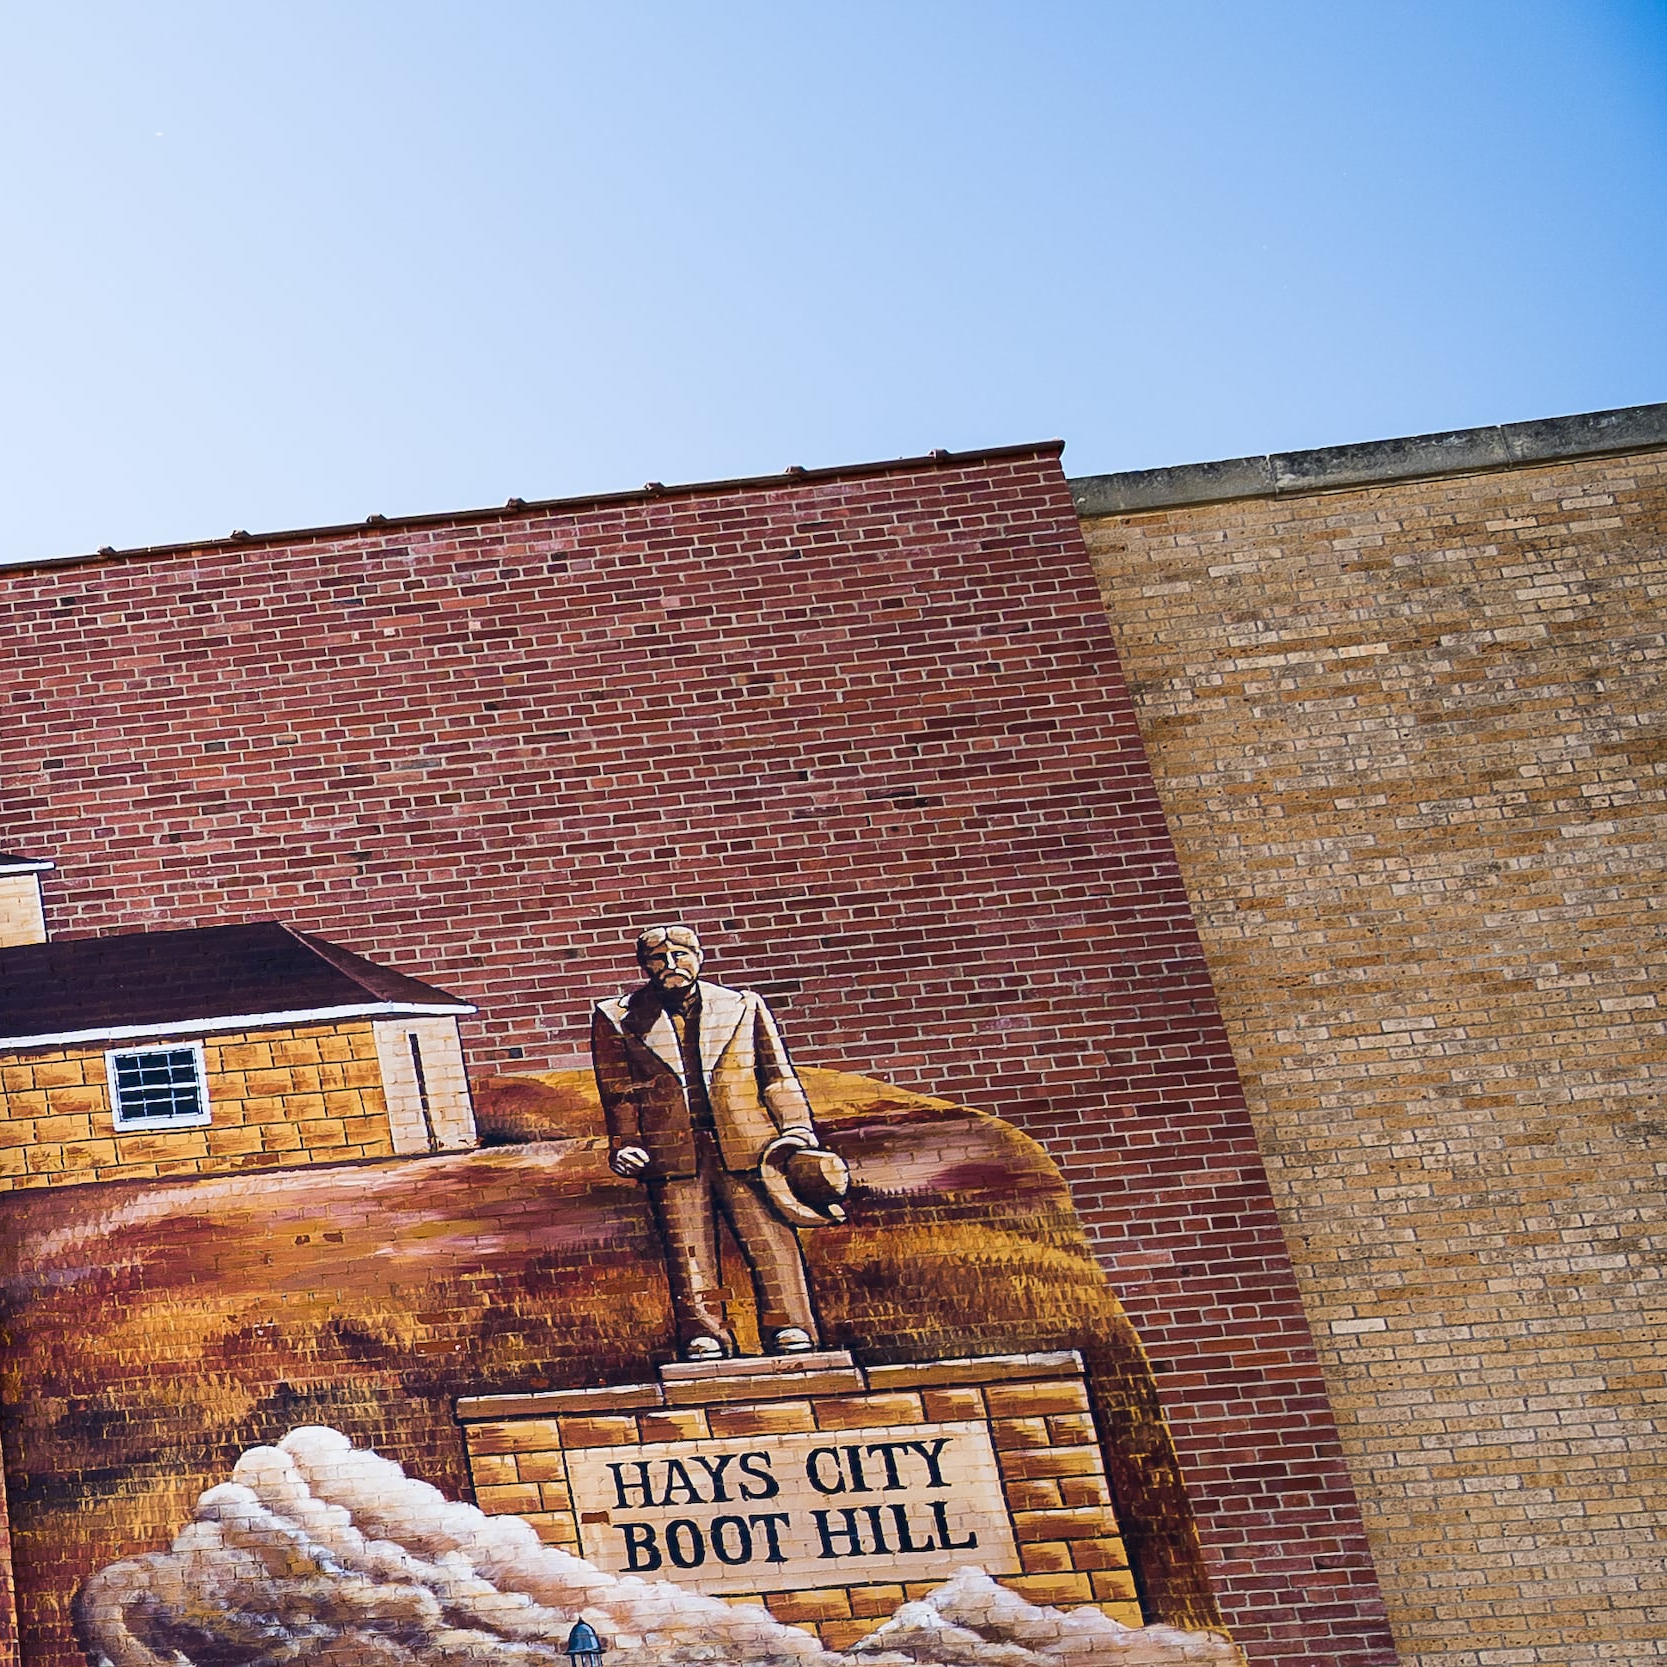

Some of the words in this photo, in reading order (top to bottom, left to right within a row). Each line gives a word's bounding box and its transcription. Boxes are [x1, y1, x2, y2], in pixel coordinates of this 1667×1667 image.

[605, 1450, 779, 1510] HAYS
[806, 1438, 953, 1496] CITY
[615, 1512, 791, 1573] BOOT
[811, 1501, 978, 1559] HILL
